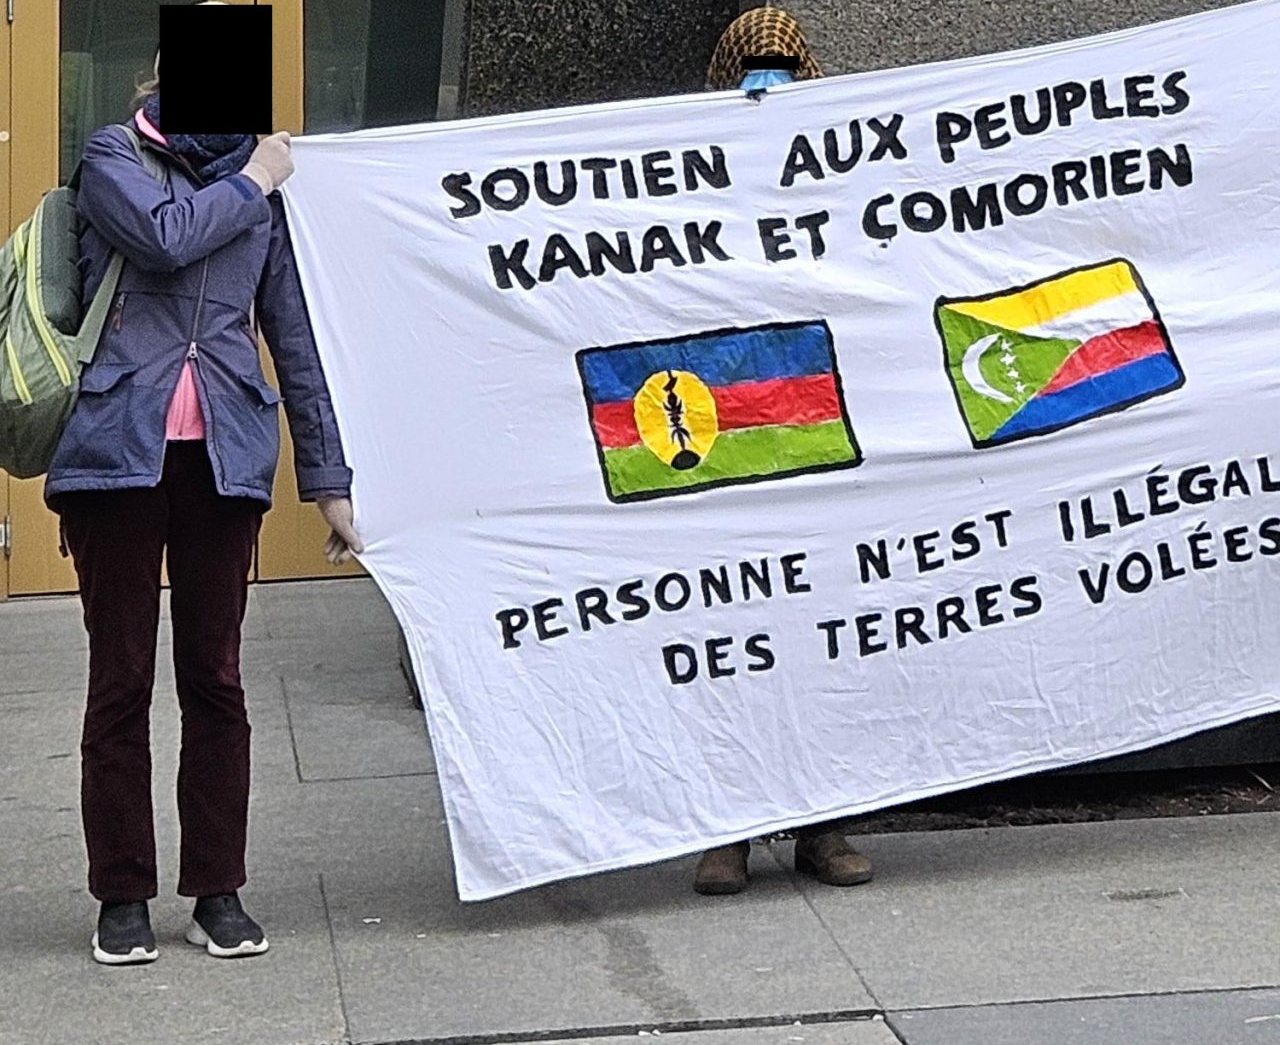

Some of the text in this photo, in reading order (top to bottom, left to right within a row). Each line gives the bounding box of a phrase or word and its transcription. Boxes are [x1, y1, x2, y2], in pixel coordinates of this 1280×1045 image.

[441, 71, 1190, 219] SOUTIEN AUX PEUPLES
[488, 220, 730, 290] KANAK
[757, 210, 830, 263] ET
[495, 552, 811, 649] PERSONNE
[856, 509, 1012, 584] N'EST
[661, 633, 775, 685] DES
[816, 575, 1042, 659] TERRES
